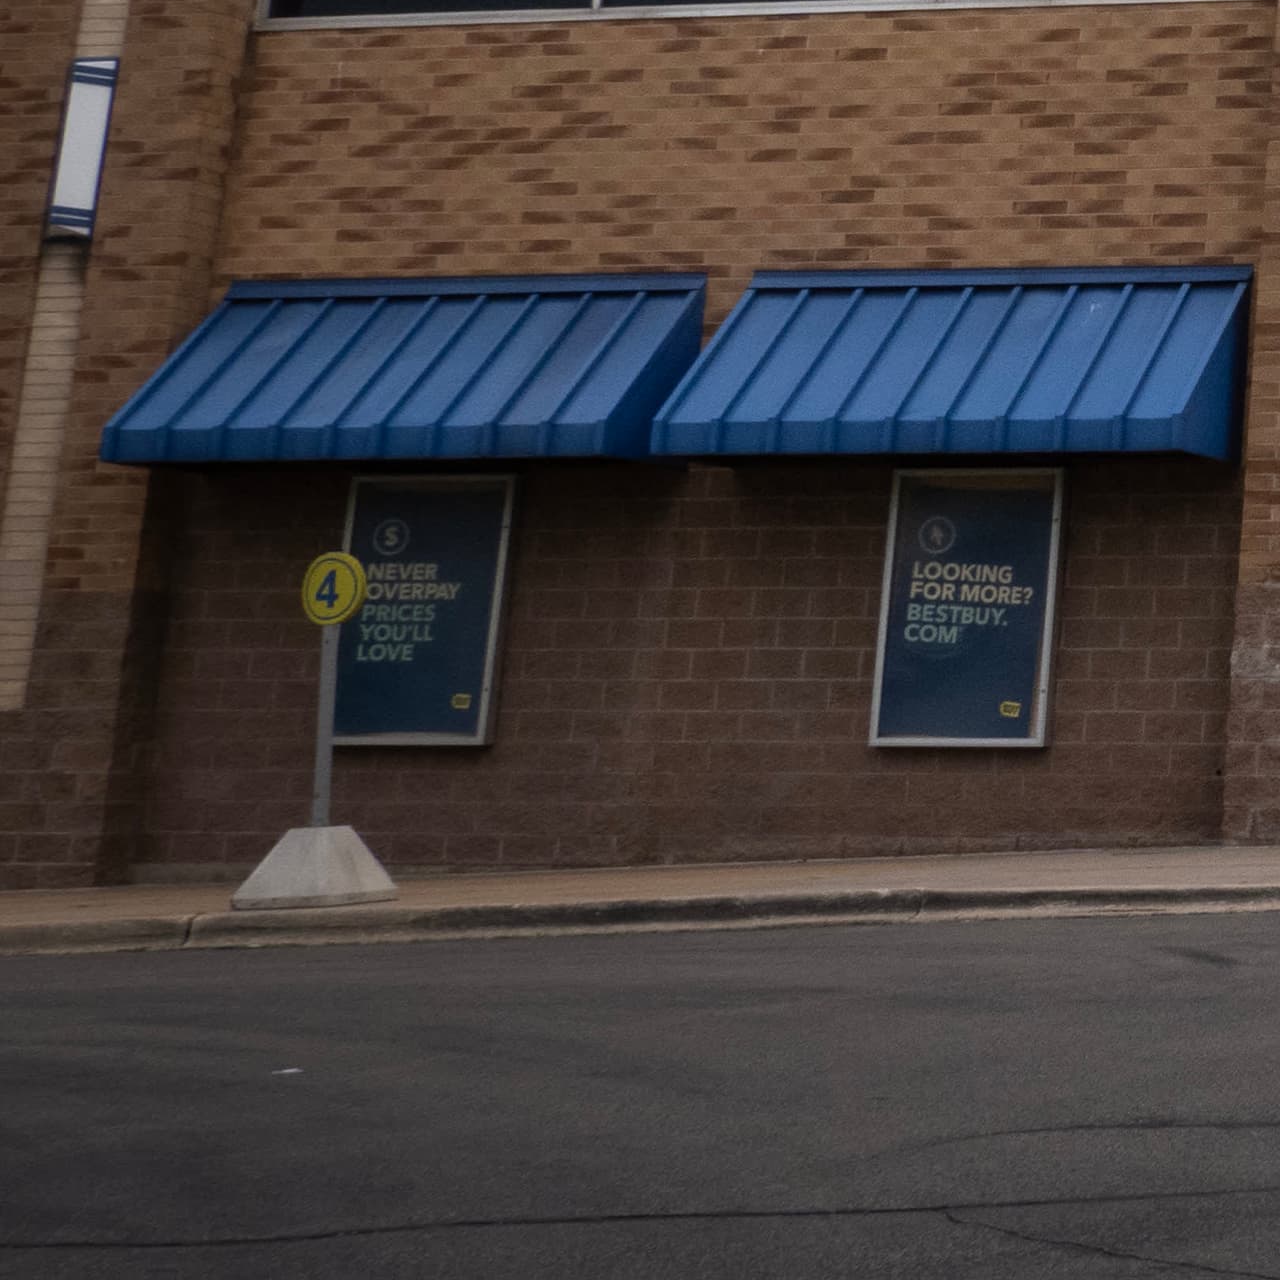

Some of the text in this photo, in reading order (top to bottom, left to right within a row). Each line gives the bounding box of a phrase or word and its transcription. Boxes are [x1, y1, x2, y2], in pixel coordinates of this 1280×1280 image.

[368, 563, 438, 581] NEVER
[912, 561, 1013, 584] LOOKING
[315, 569, 340, 609] 4
[366, 582, 461, 601] OVERPAY
[909, 581, 1034, 605] FOR MORE?
[361, 604, 436, 622] PRICES
[907, 603, 1009, 626] BESTBUY.
[360, 624, 433, 642] YOU'LL
[356, 644, 415, 662] LOVE
